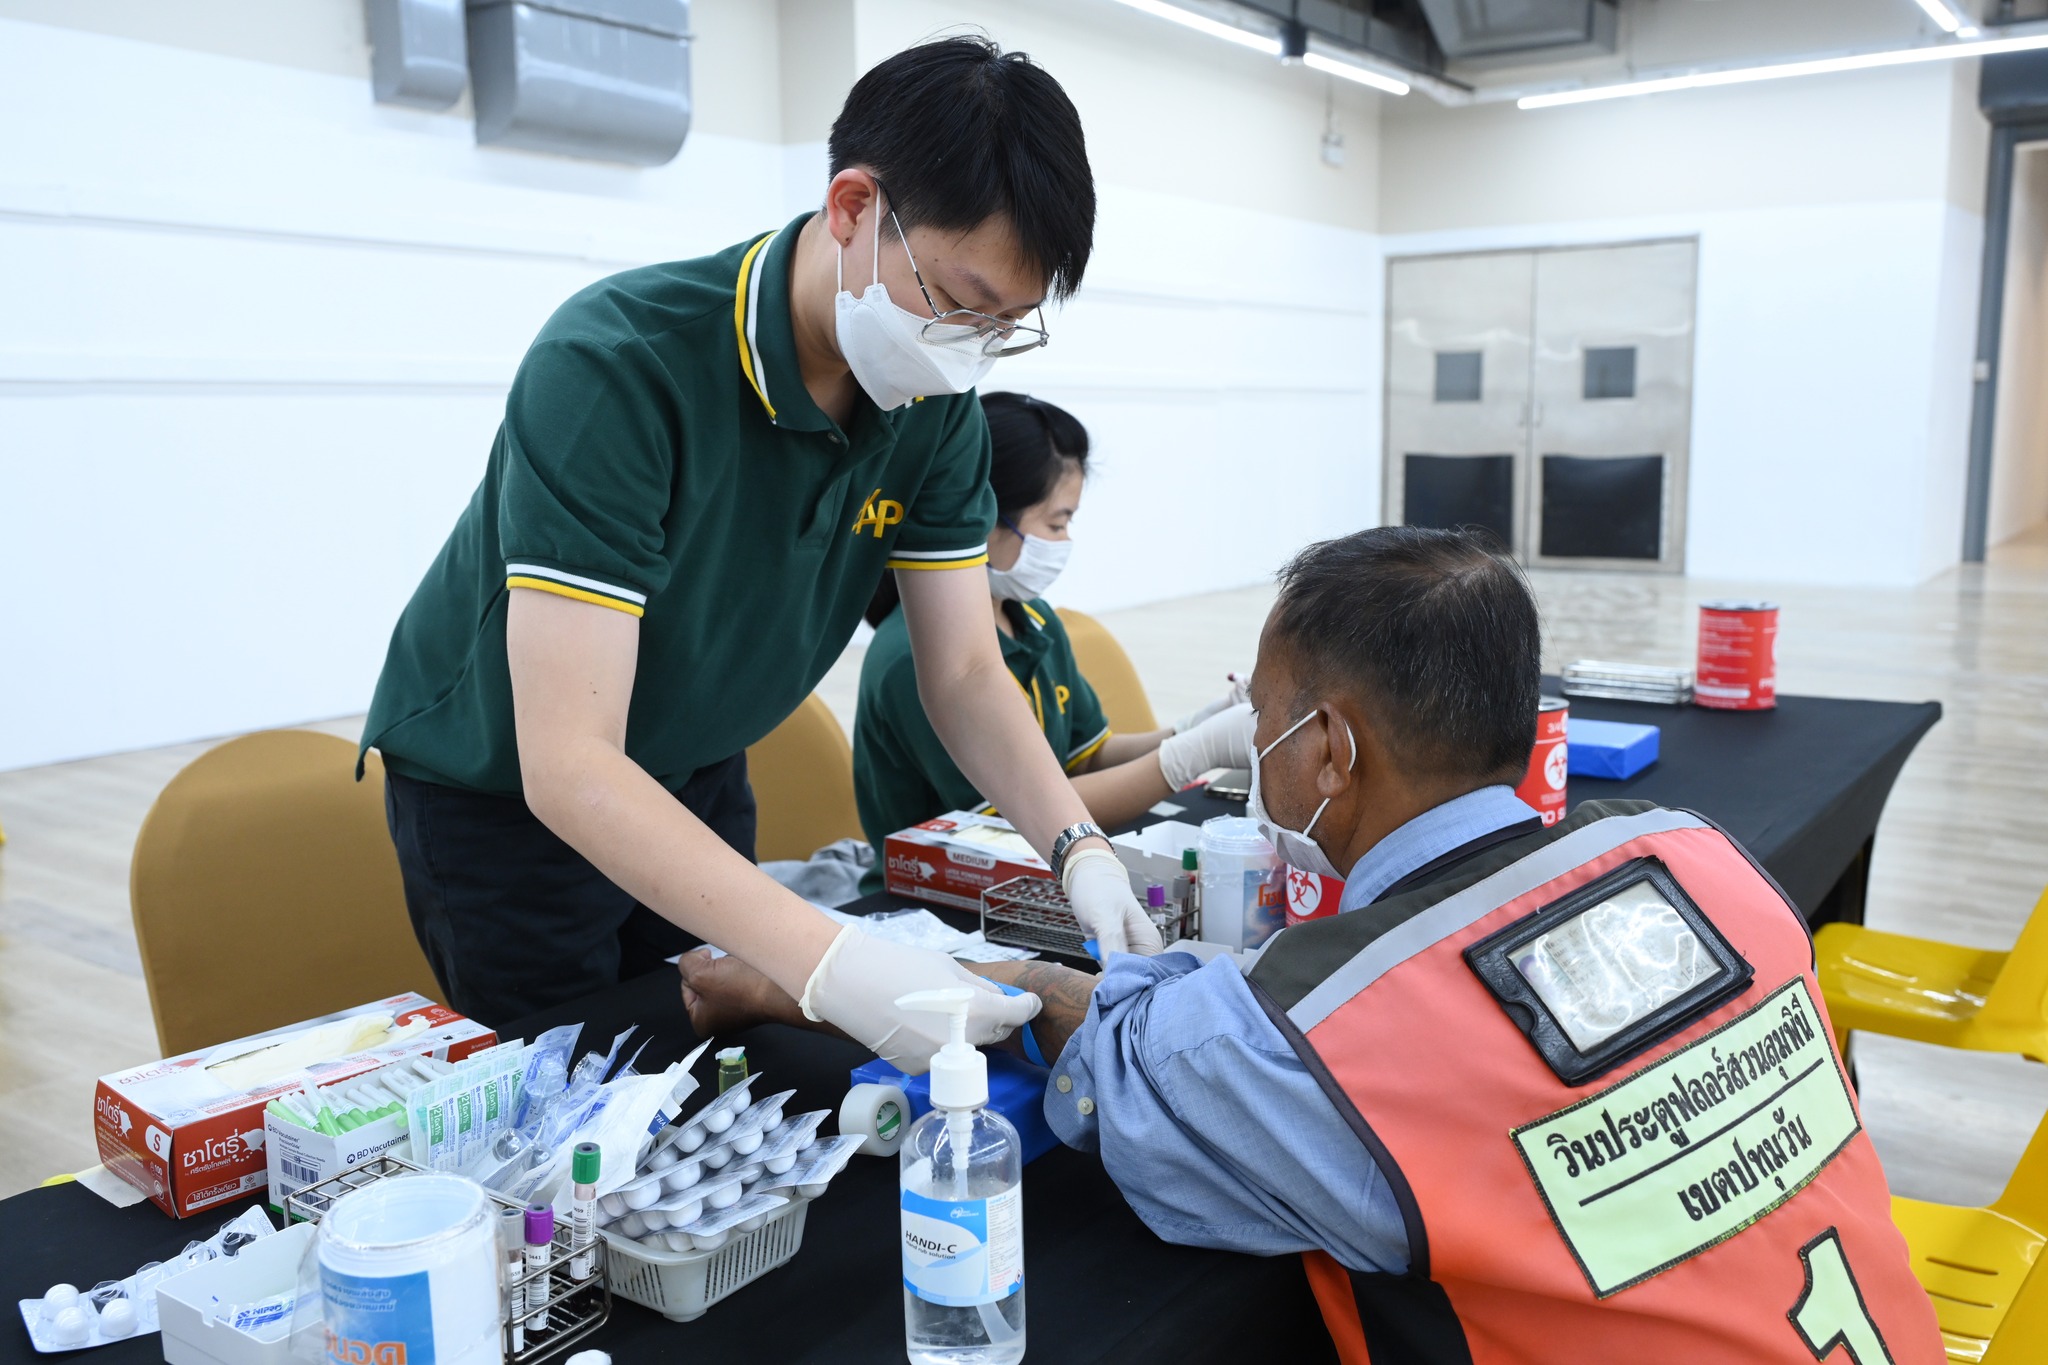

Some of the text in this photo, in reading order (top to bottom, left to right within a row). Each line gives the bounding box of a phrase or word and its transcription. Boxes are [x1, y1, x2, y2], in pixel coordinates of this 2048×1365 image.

[952, 853, 989, 867] MEDIUM
[153, 1133, 161, 1152] S
[357, 1132, 410, 1160] BD Vacutainer
[1677, 1106, 1813, 1221] เขตปทุมวัน
[905, 1230, 957, 1254] HANDI-C
[929, 1252, 956, 1261] solution
